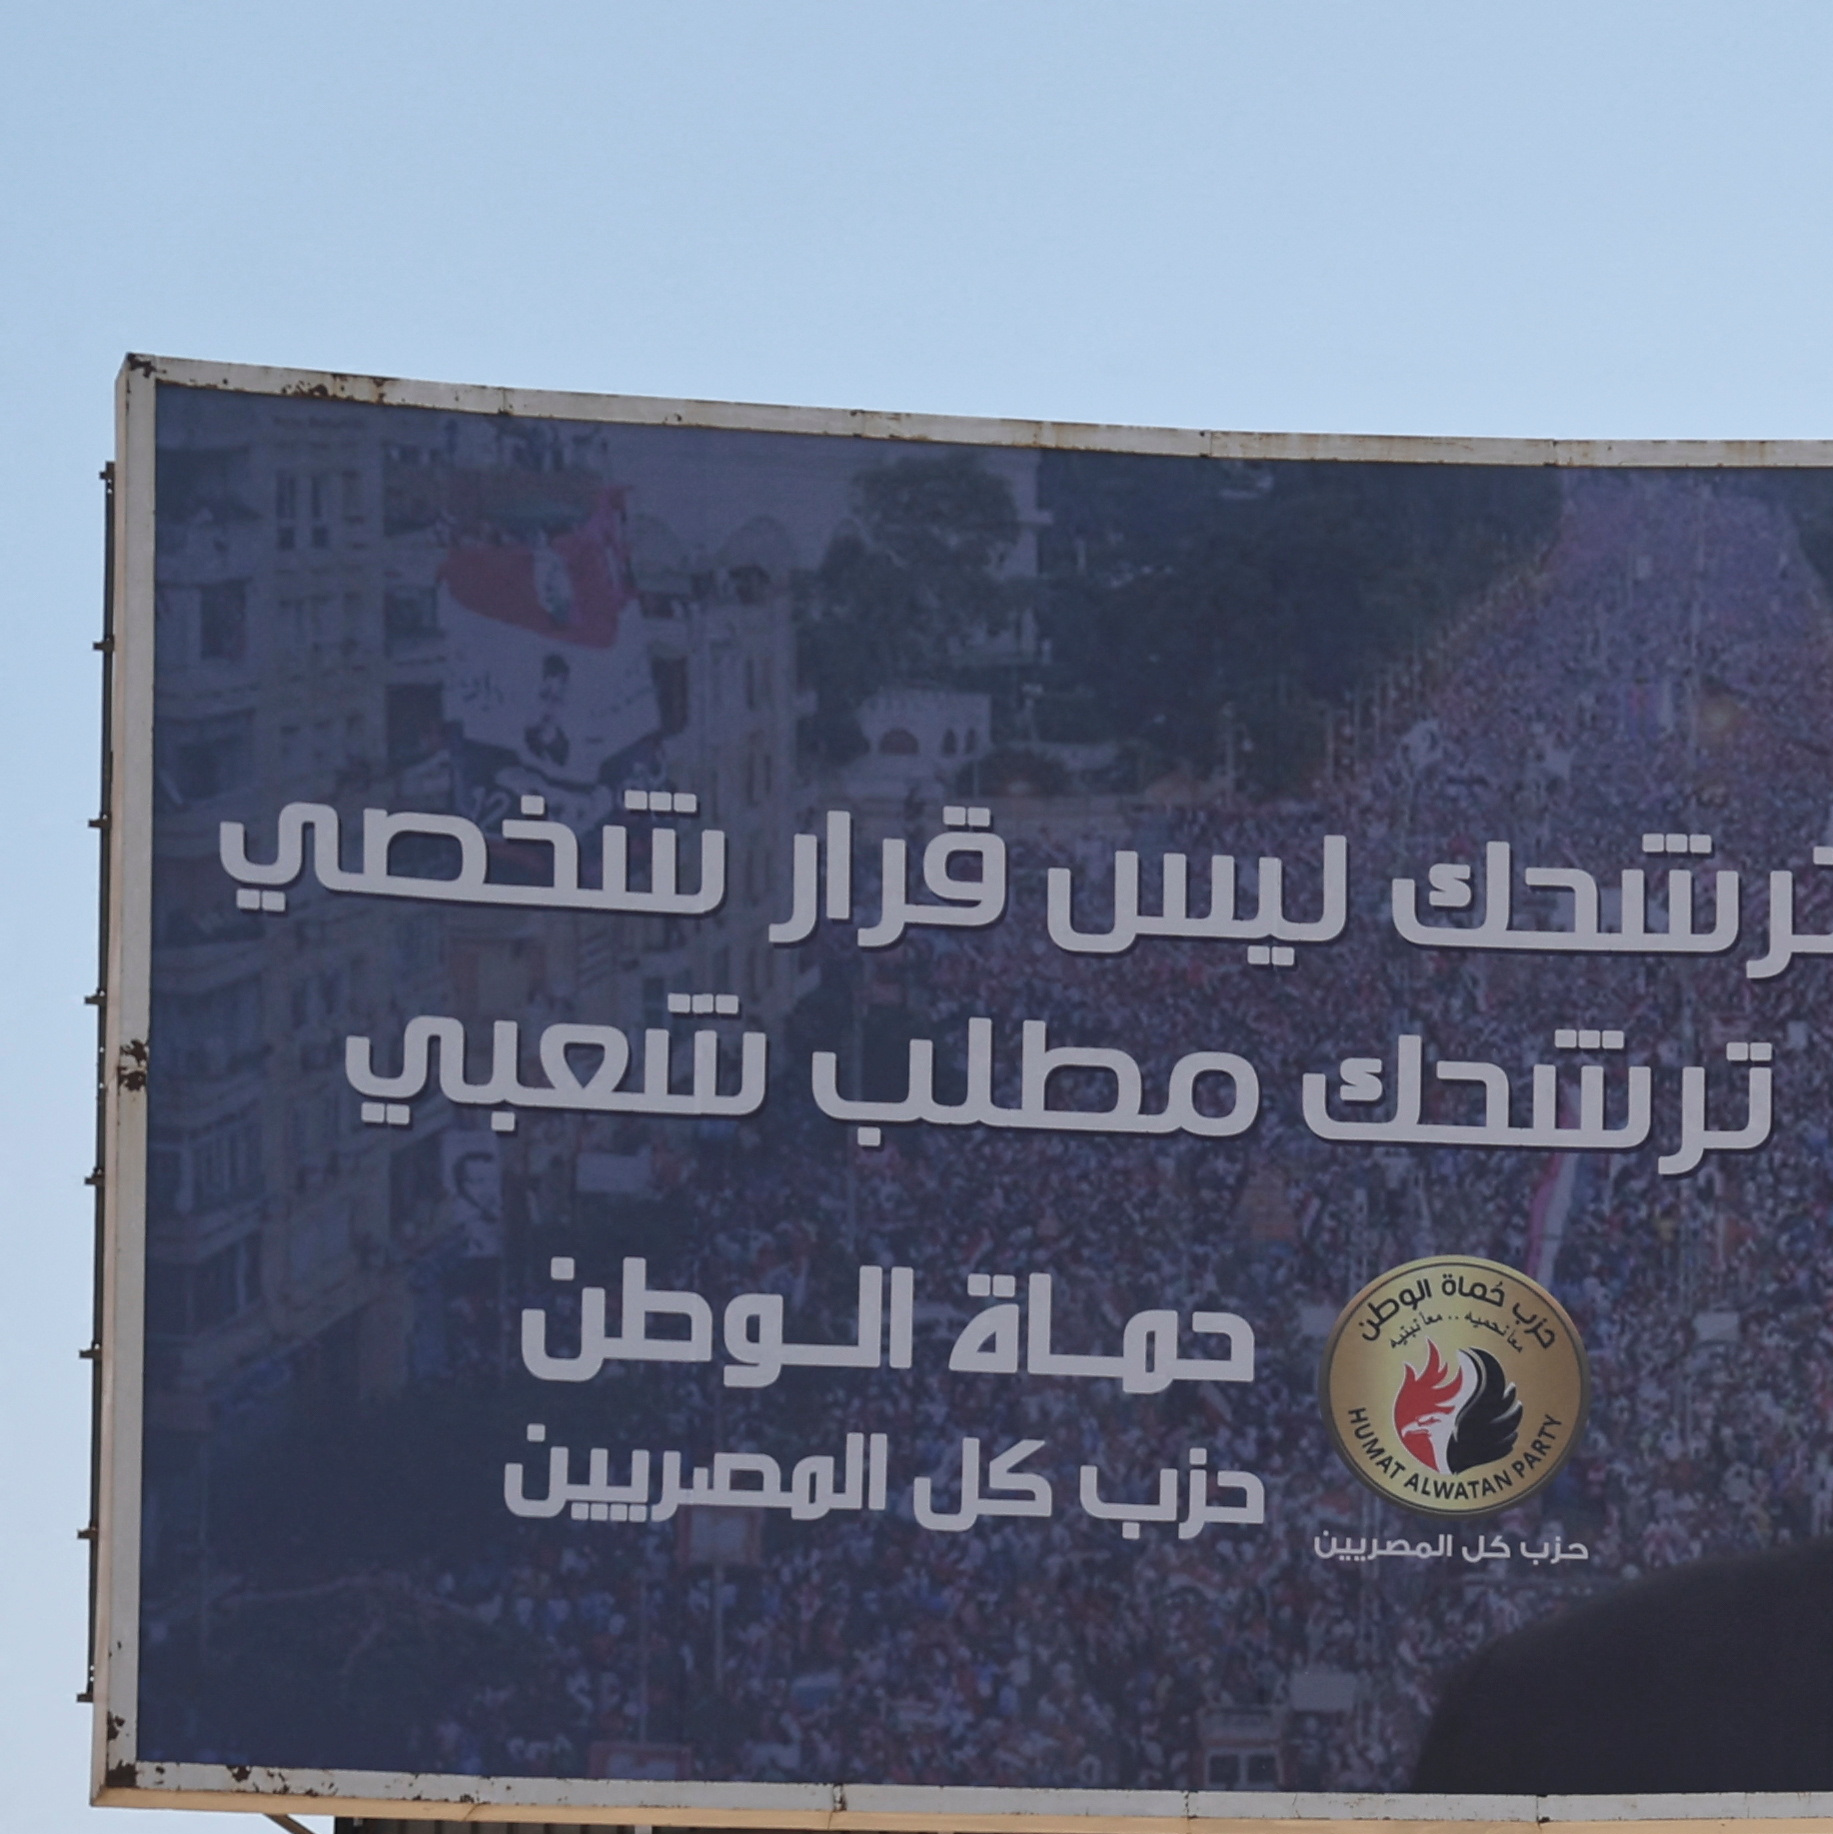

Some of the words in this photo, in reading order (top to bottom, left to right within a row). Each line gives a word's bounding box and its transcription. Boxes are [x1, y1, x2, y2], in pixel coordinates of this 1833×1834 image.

[218, 789, 726, 914] شخصي
[768, 805, 1006, 947] قرار
[1047, 834, 1348, 967] ليس
[345, 993, 767, 1131] شعبي
[811, 1017, 1260, 1147] مطلب
[1301, 1029, 1773, 1175] ترشحك
[520, 1256, 915, 1388] الوطن
[948, 1272, 1256, 1394] حماة
[1359, 1278, 1433, 1342] الوطن
[1511, 1302, 1558, 1350] حزب
[503, 1423, 888, 1523] المصريين
[912, 1436, 1053, 1532] كل
[1080, 1446, 1266, 1541] حزب
[1348, 1406, 1407, 1480] HUMAT
[1404, 1473, 1514, 1500] ALWATAN
[1511, 1414, 1563, 1479] PARTY
[1313, 1530, 1453, 1562] المصريين
[1461, 1535, 1512, 1563] كل
[1520, 1535, 1589, 1566] حزب
